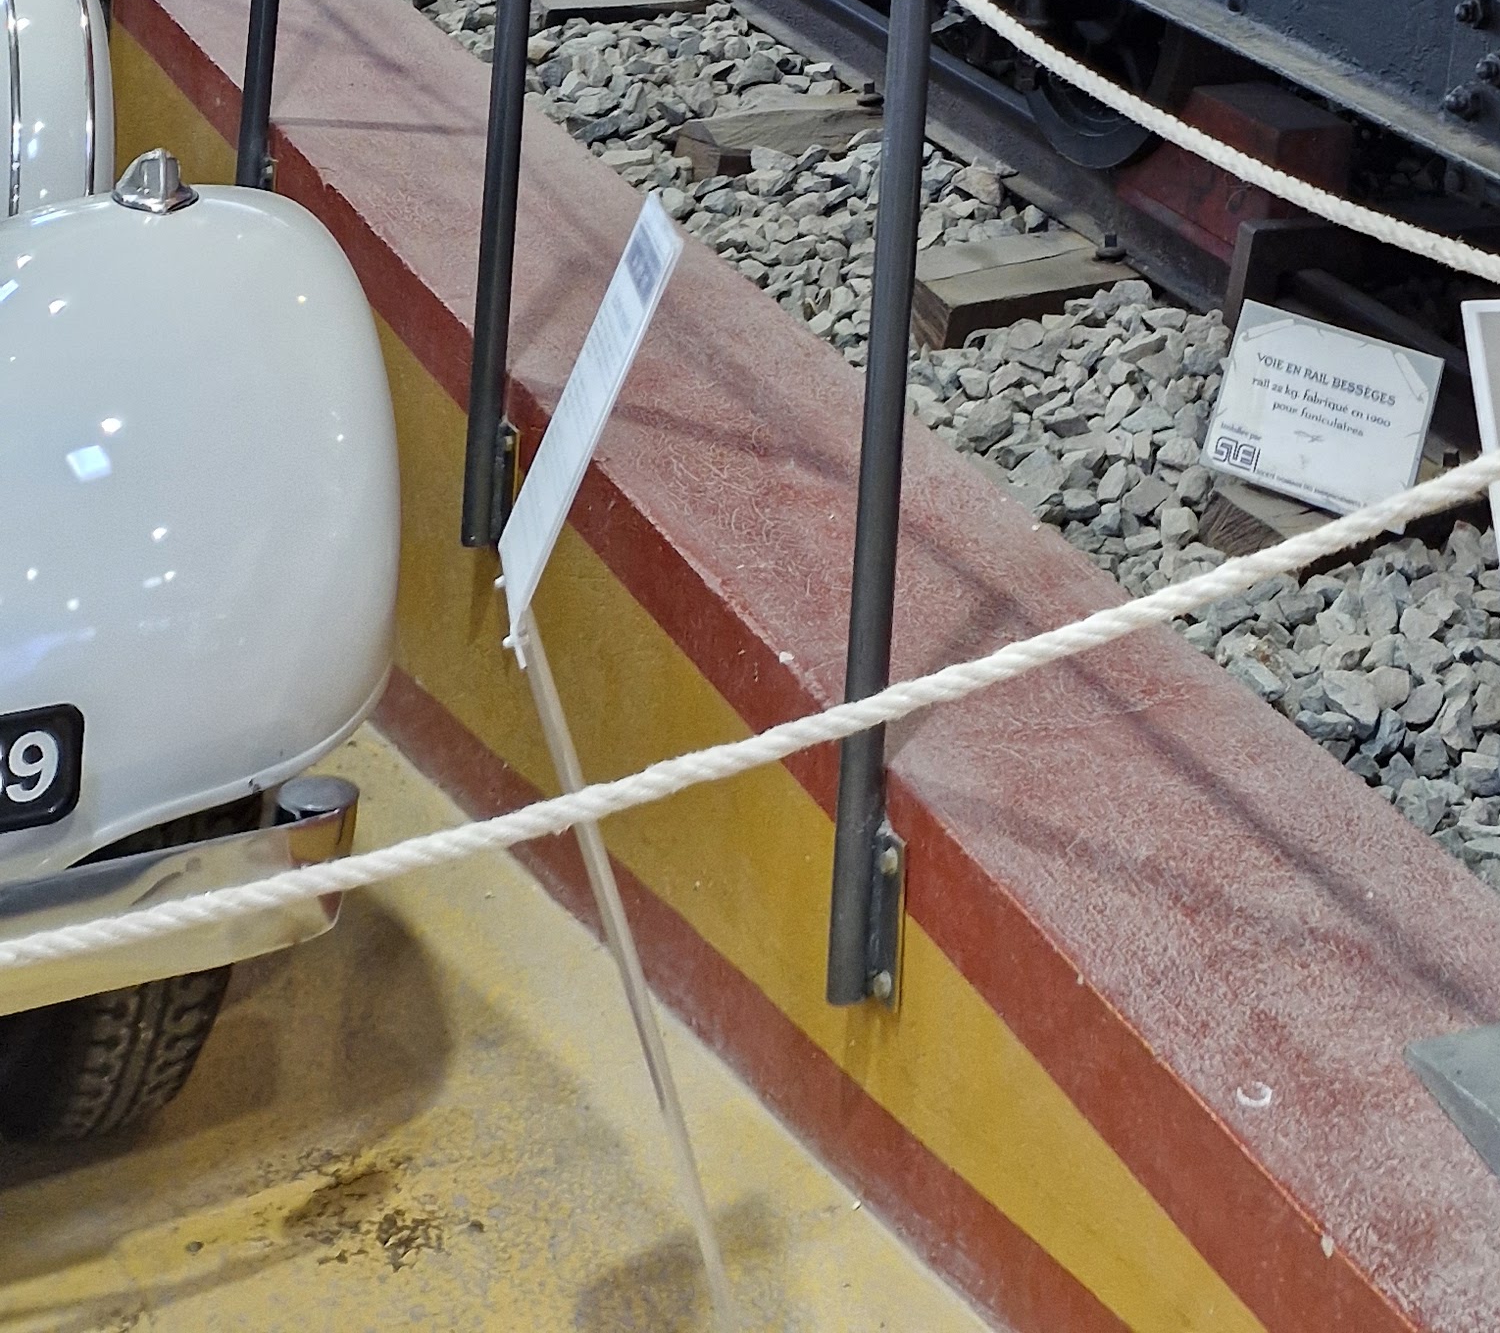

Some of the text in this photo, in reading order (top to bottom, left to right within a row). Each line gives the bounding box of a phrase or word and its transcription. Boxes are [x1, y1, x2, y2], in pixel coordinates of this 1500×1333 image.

[1257, 352, 1284, 370] VOIE
[1286, 362, 1302, 376] EN
[1304, 368, 1329, 386] RAIL
[1252, 377, 1270, 388] rail
[1272, 384, 1283, 393] 22
[1303, 388, 1349, 414] fabriqué
[1351, 408, 1363, 420] en
[1366, 412, 1391, 428] 1900
[1272, 401, 1364, 437] pour funiculaires
[0, 731, 59, 803] 9
